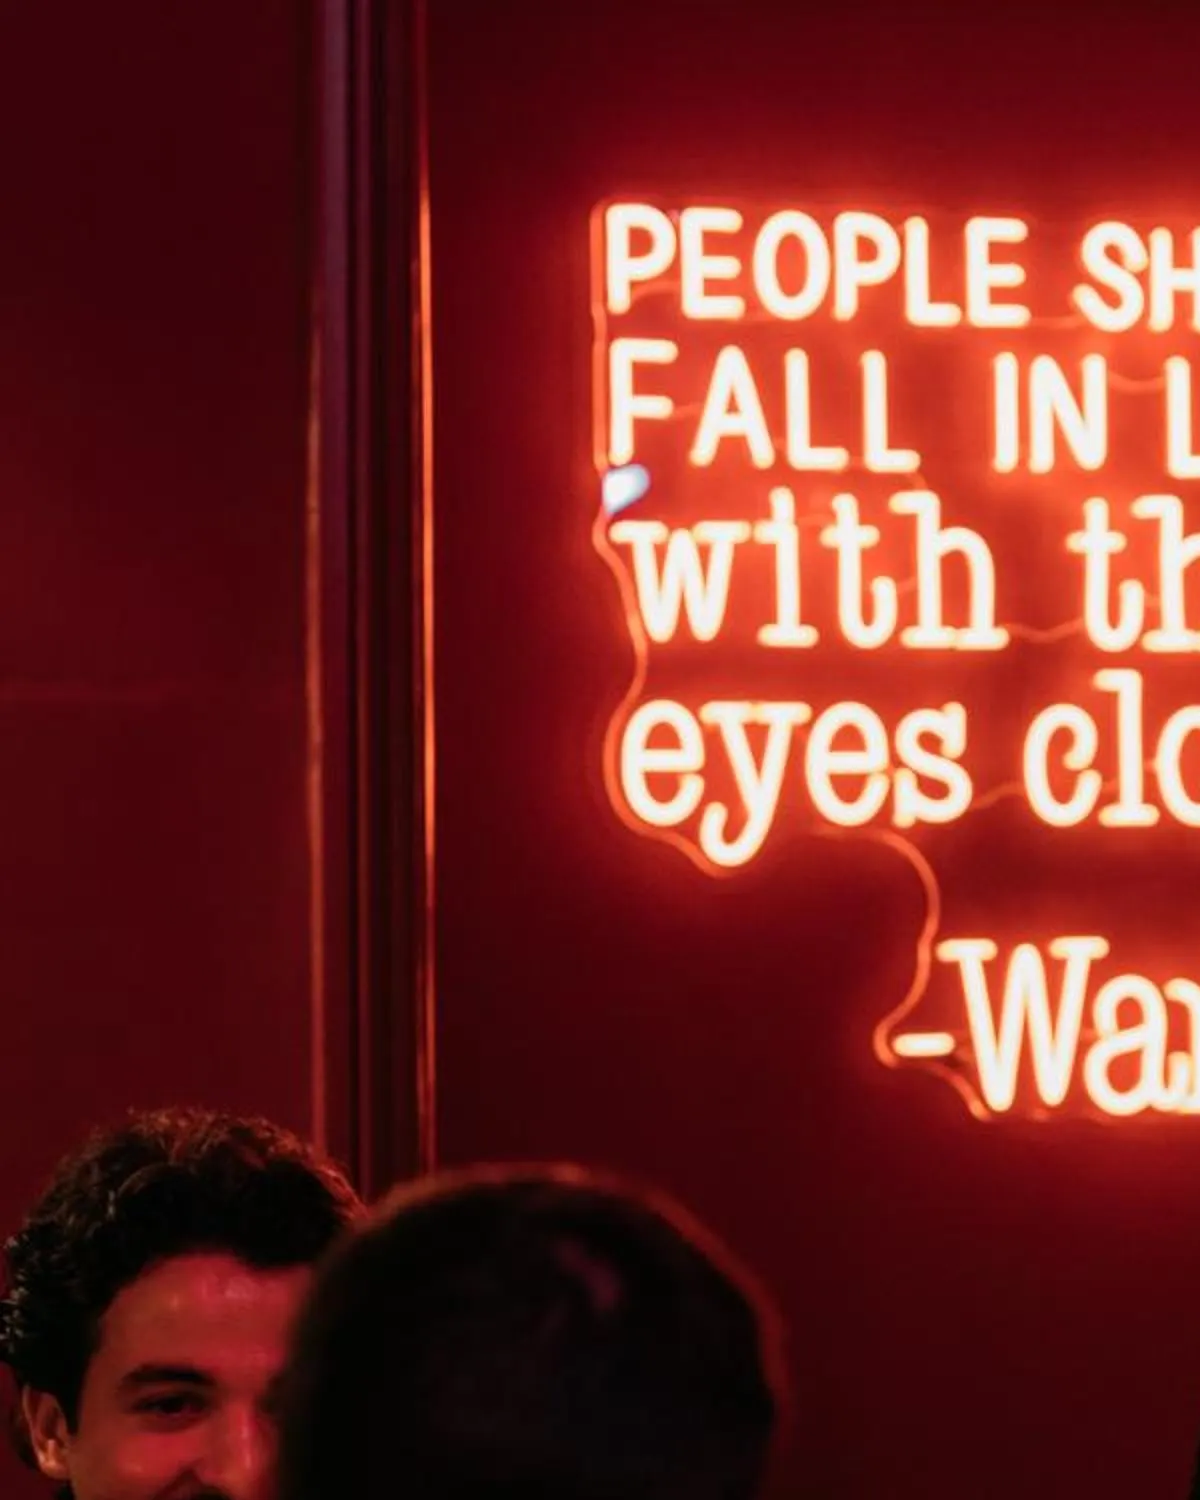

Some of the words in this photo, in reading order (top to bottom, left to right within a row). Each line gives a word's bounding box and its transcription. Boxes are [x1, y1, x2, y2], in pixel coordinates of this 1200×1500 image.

[605, 203, 1032, 329] PEOPLE
[607, 338, 920, 474] FALL
[992, 351, 1109, 475] IN
[608, 486, 1010, 650] with
[620, 700, 973, 867] eyes
